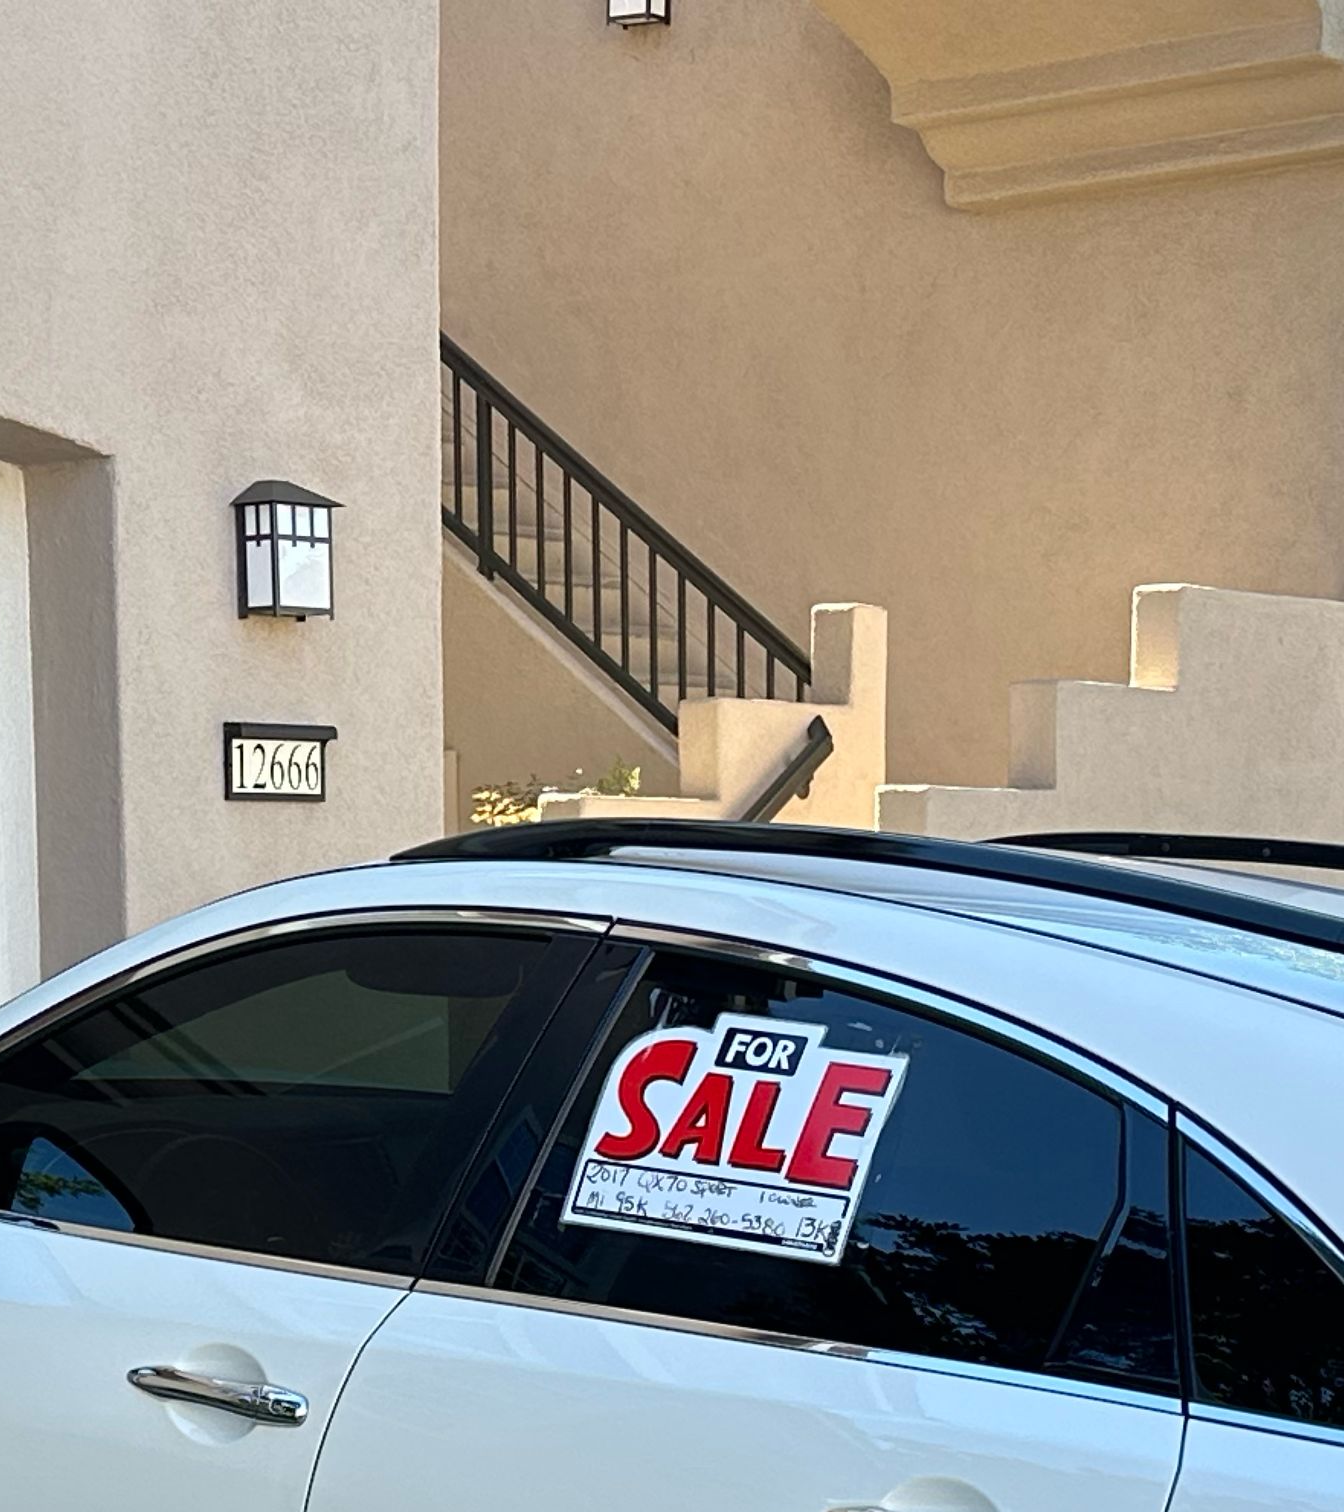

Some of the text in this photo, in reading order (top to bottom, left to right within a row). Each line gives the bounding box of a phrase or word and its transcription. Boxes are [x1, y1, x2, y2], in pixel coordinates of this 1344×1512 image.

[234, 743, 319, 790] 12666
[725, 1034, 795, 1070] FOR
[594, 1039, 892, 1189] SALE
[587, 1165, 630, 1187] 2017
[638, 1171, 687, 1193] QX70
